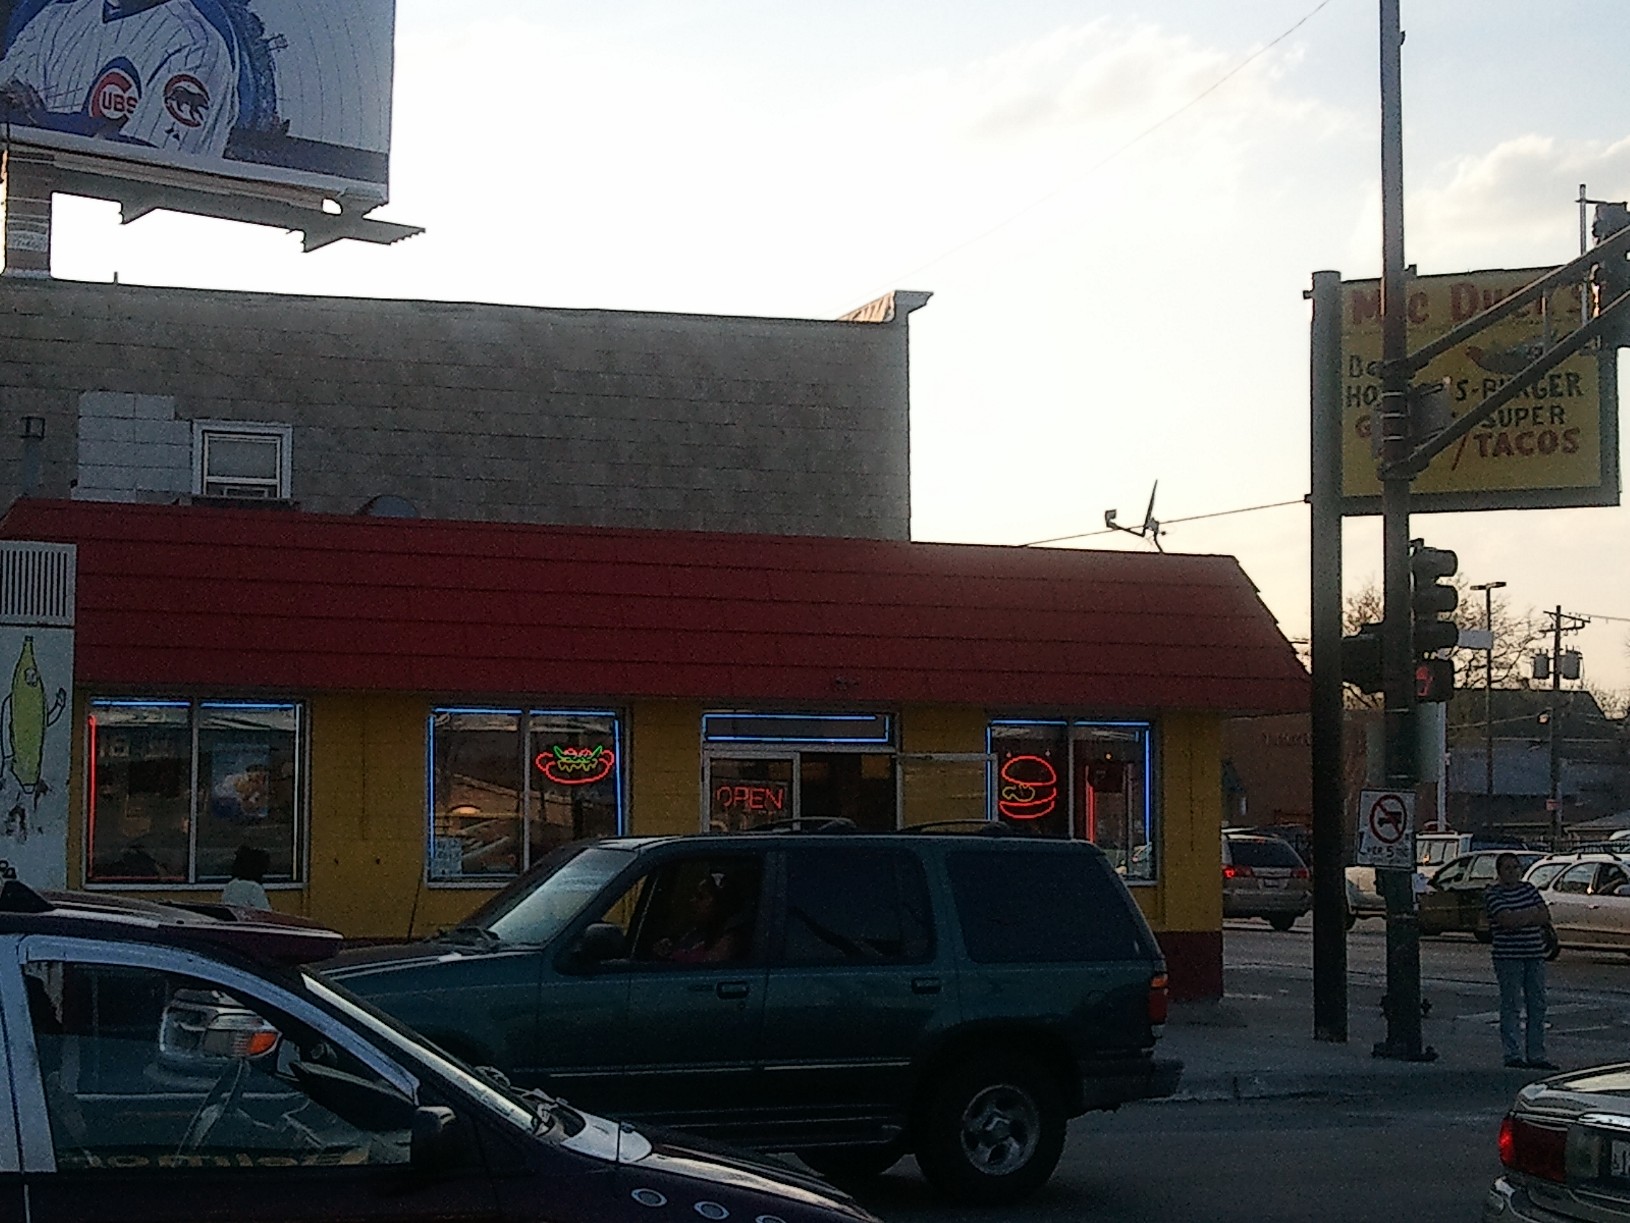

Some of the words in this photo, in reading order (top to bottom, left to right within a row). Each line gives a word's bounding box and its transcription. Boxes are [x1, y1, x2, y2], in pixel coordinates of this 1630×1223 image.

[1481, 405, 1566, 429] SUPER
[1473, 427, 1582, 459] TACOS
[715, 784, 785, 811] OPEN
